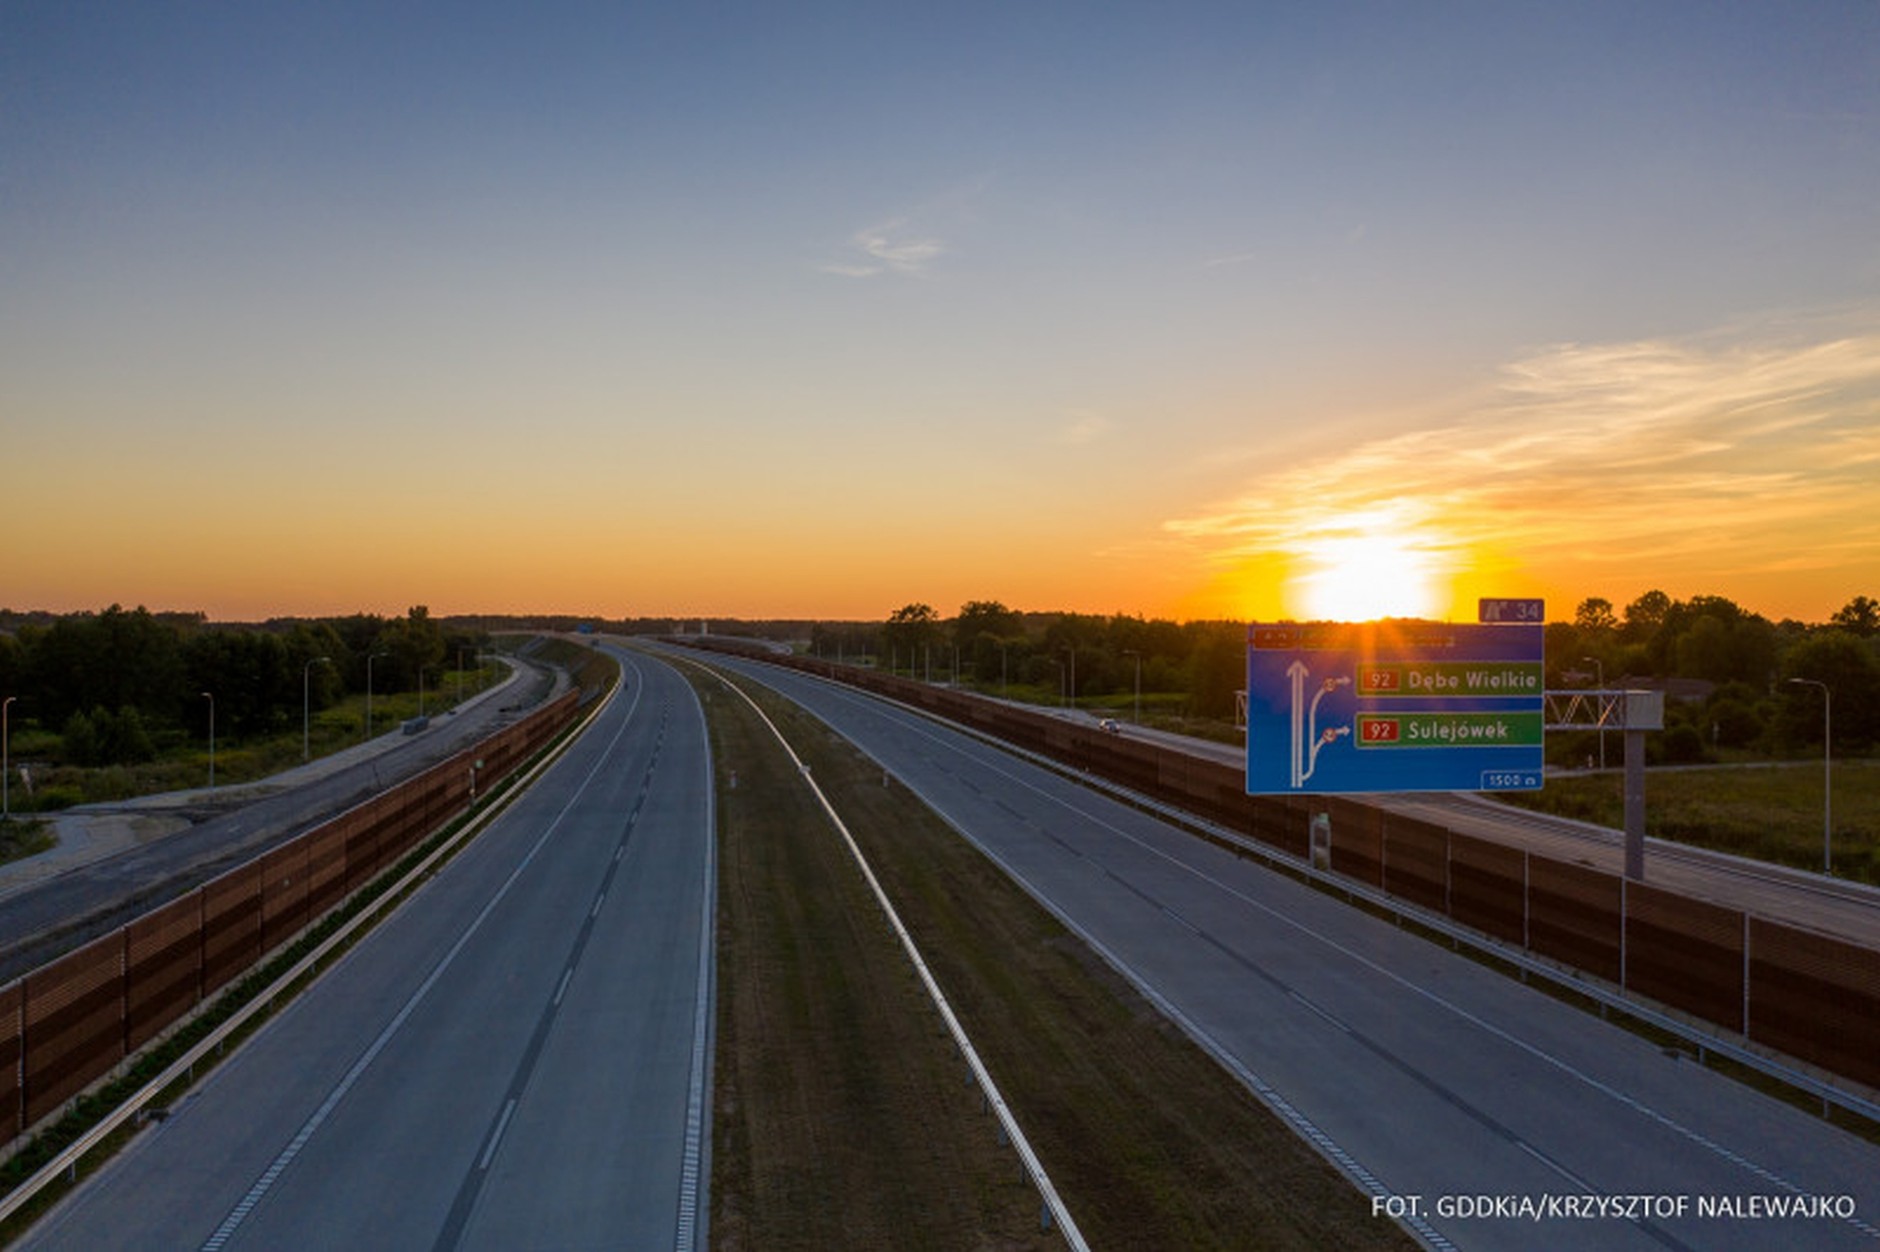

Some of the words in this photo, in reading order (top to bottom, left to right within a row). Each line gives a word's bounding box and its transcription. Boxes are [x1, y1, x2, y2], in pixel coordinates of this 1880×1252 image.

[1516, 602, 1539, 619] 34
[1371, 672, 1391, 688] 92
[1409, 671, 1459, 691] Dębe
[1466, 671, 1537, 688] Wielkie
[1371, 722, 1391, 739] 92
[1408, 721, 1508, 742] Sulejówek
